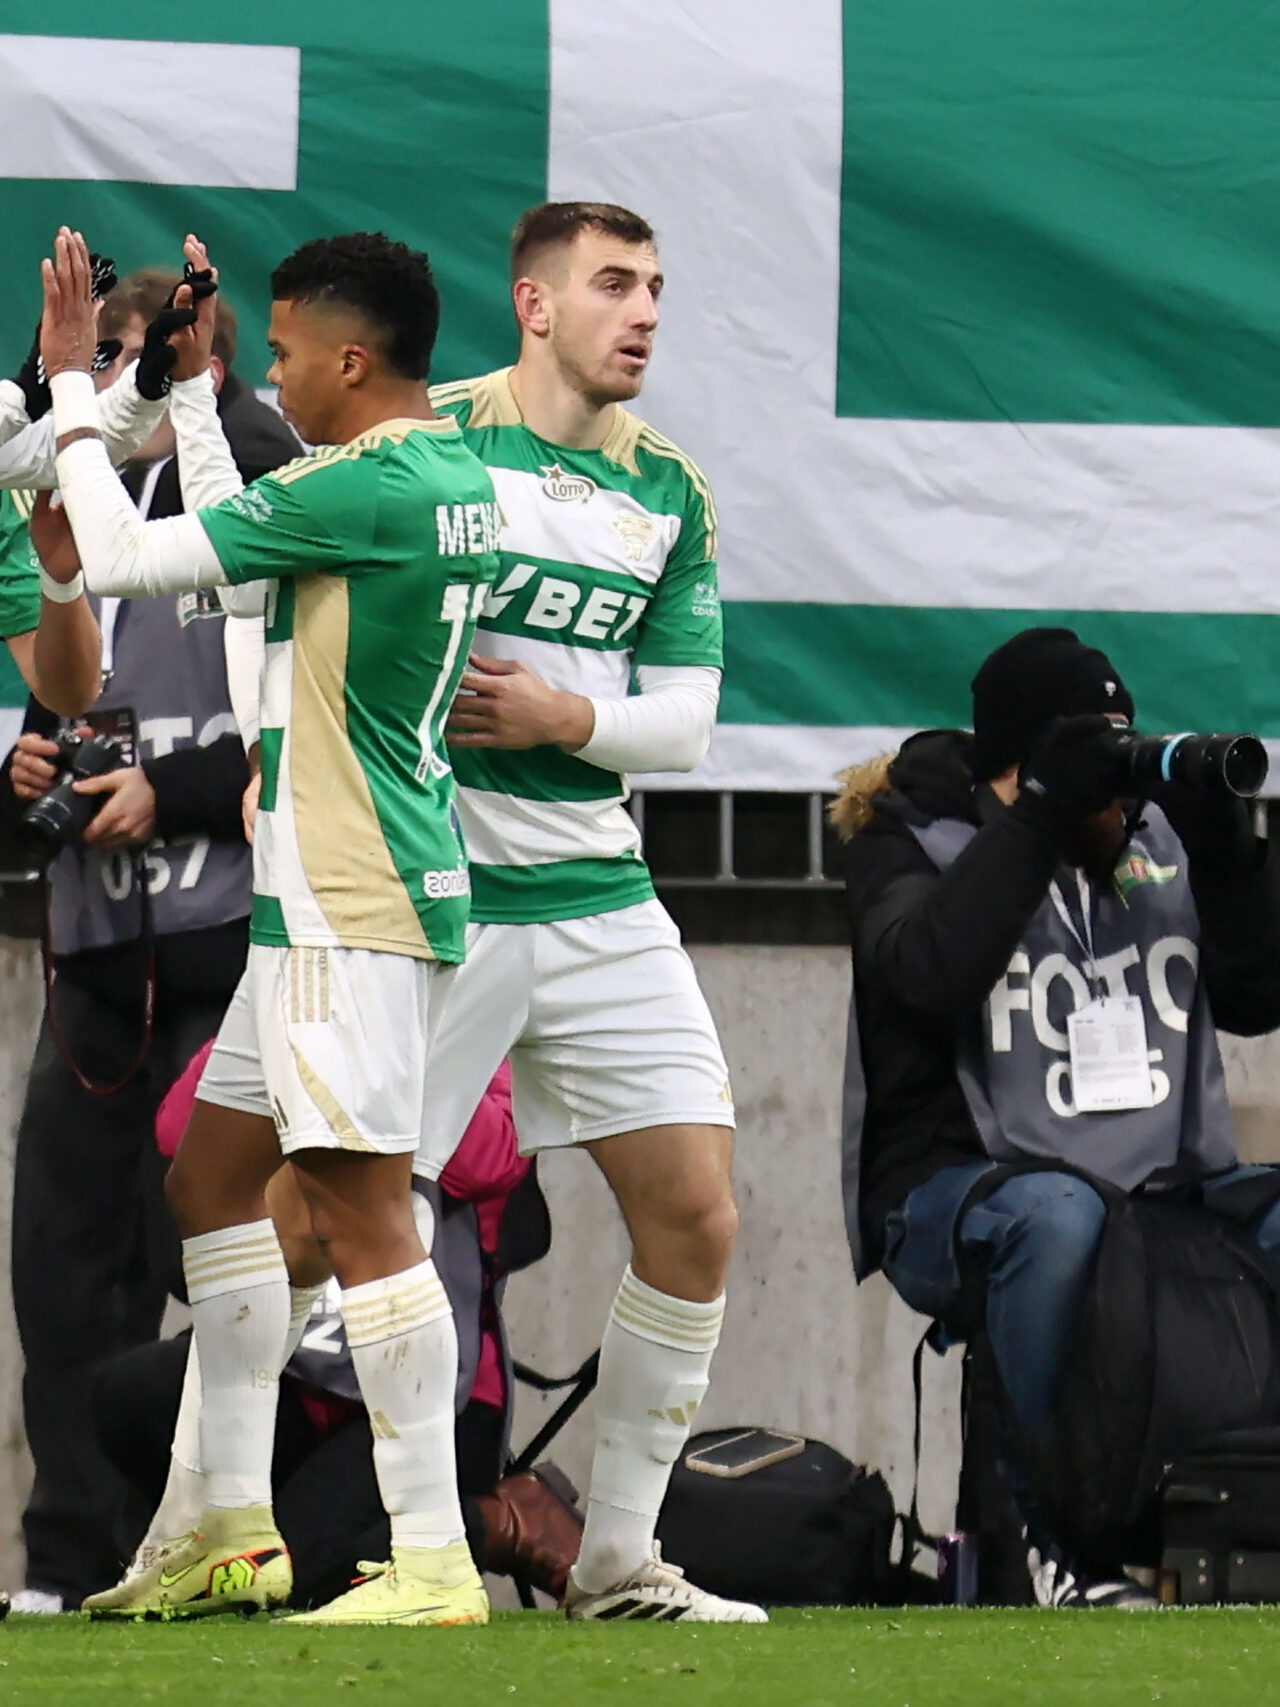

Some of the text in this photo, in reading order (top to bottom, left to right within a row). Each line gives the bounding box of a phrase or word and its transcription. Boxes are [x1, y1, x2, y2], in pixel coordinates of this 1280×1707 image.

[552, 483, 585, 497] LOTTO
[989, 935, 1199, 1053] FOTO
[1045, 1048, 1171, 1118] 05
